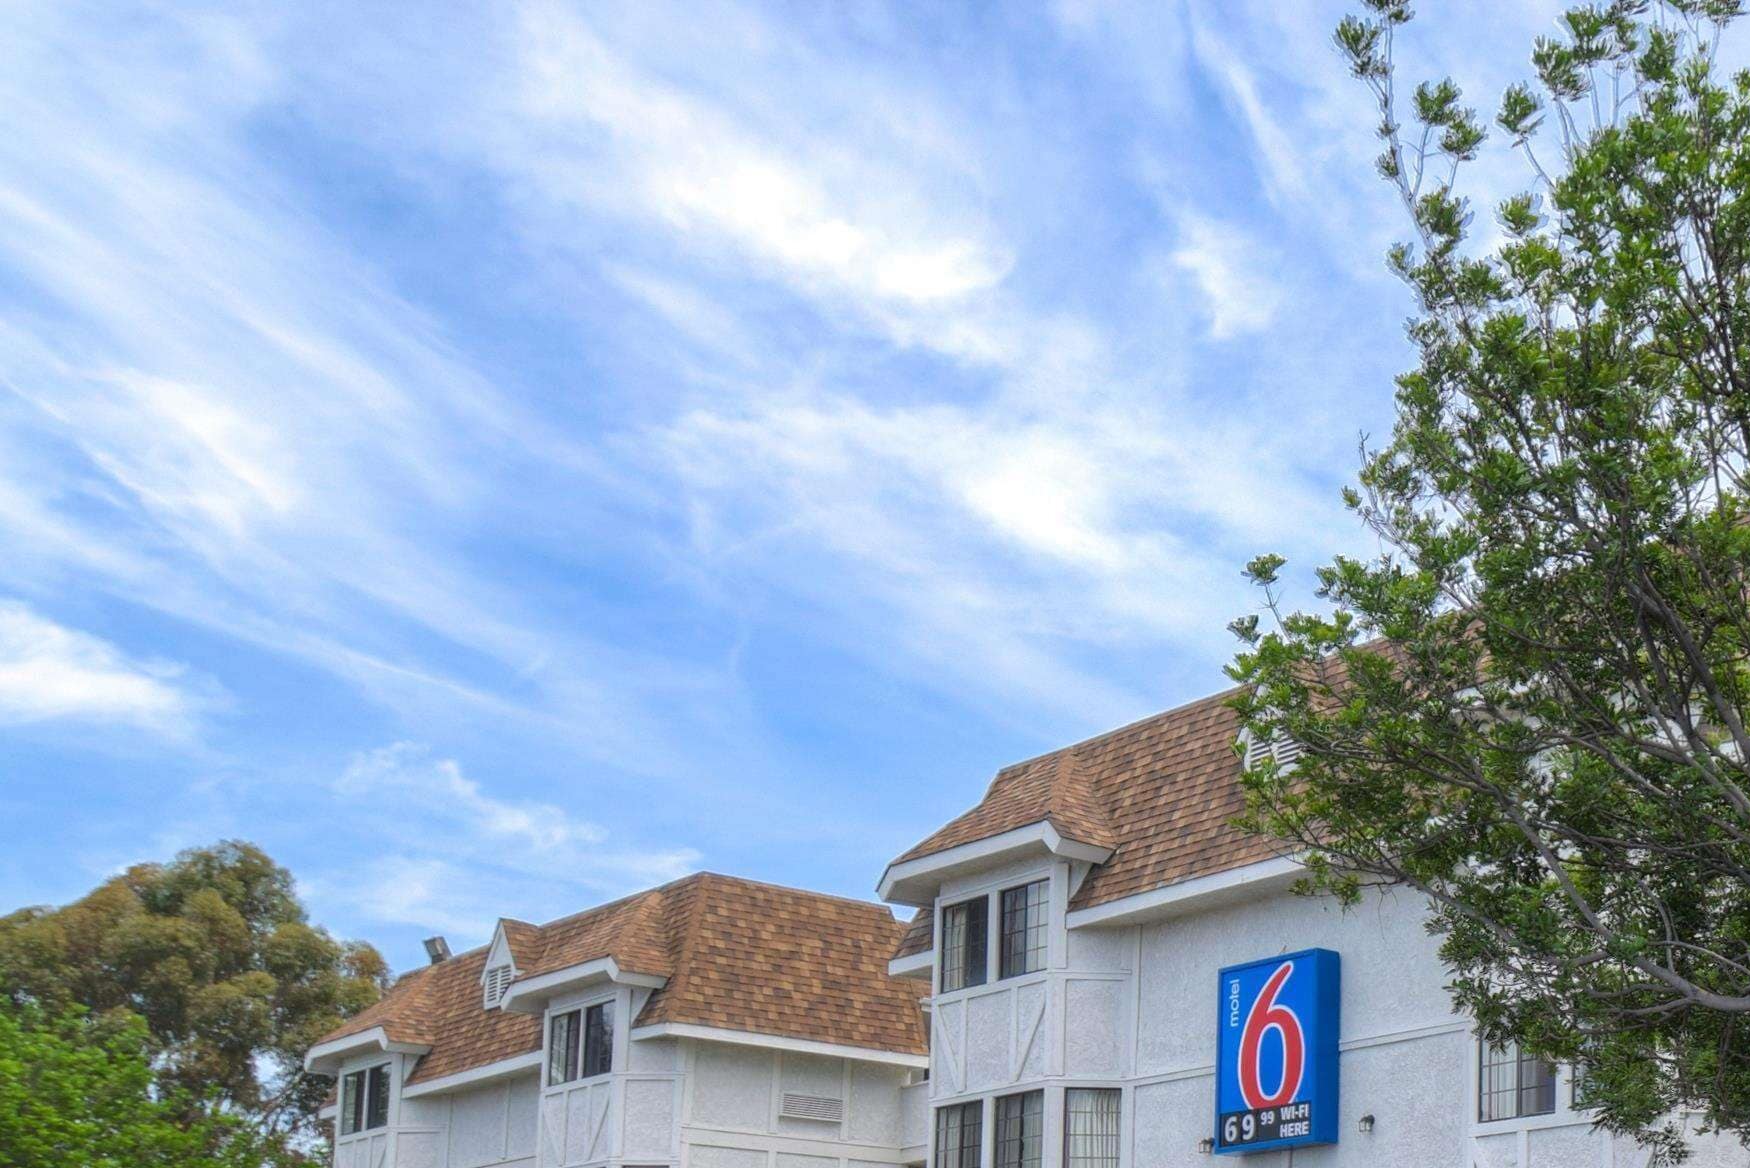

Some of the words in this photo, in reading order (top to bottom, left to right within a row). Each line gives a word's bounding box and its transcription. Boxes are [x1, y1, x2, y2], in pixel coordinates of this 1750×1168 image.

[1228, 978, 1240, 1028] motel
[1237, 960, 1305, 1110] 6
[1260, 1110, 1275, 1126] 99
[1280, 1103, 1309, 1121] WI-FI
[1280, 1121, 1309, 1138] HERE
